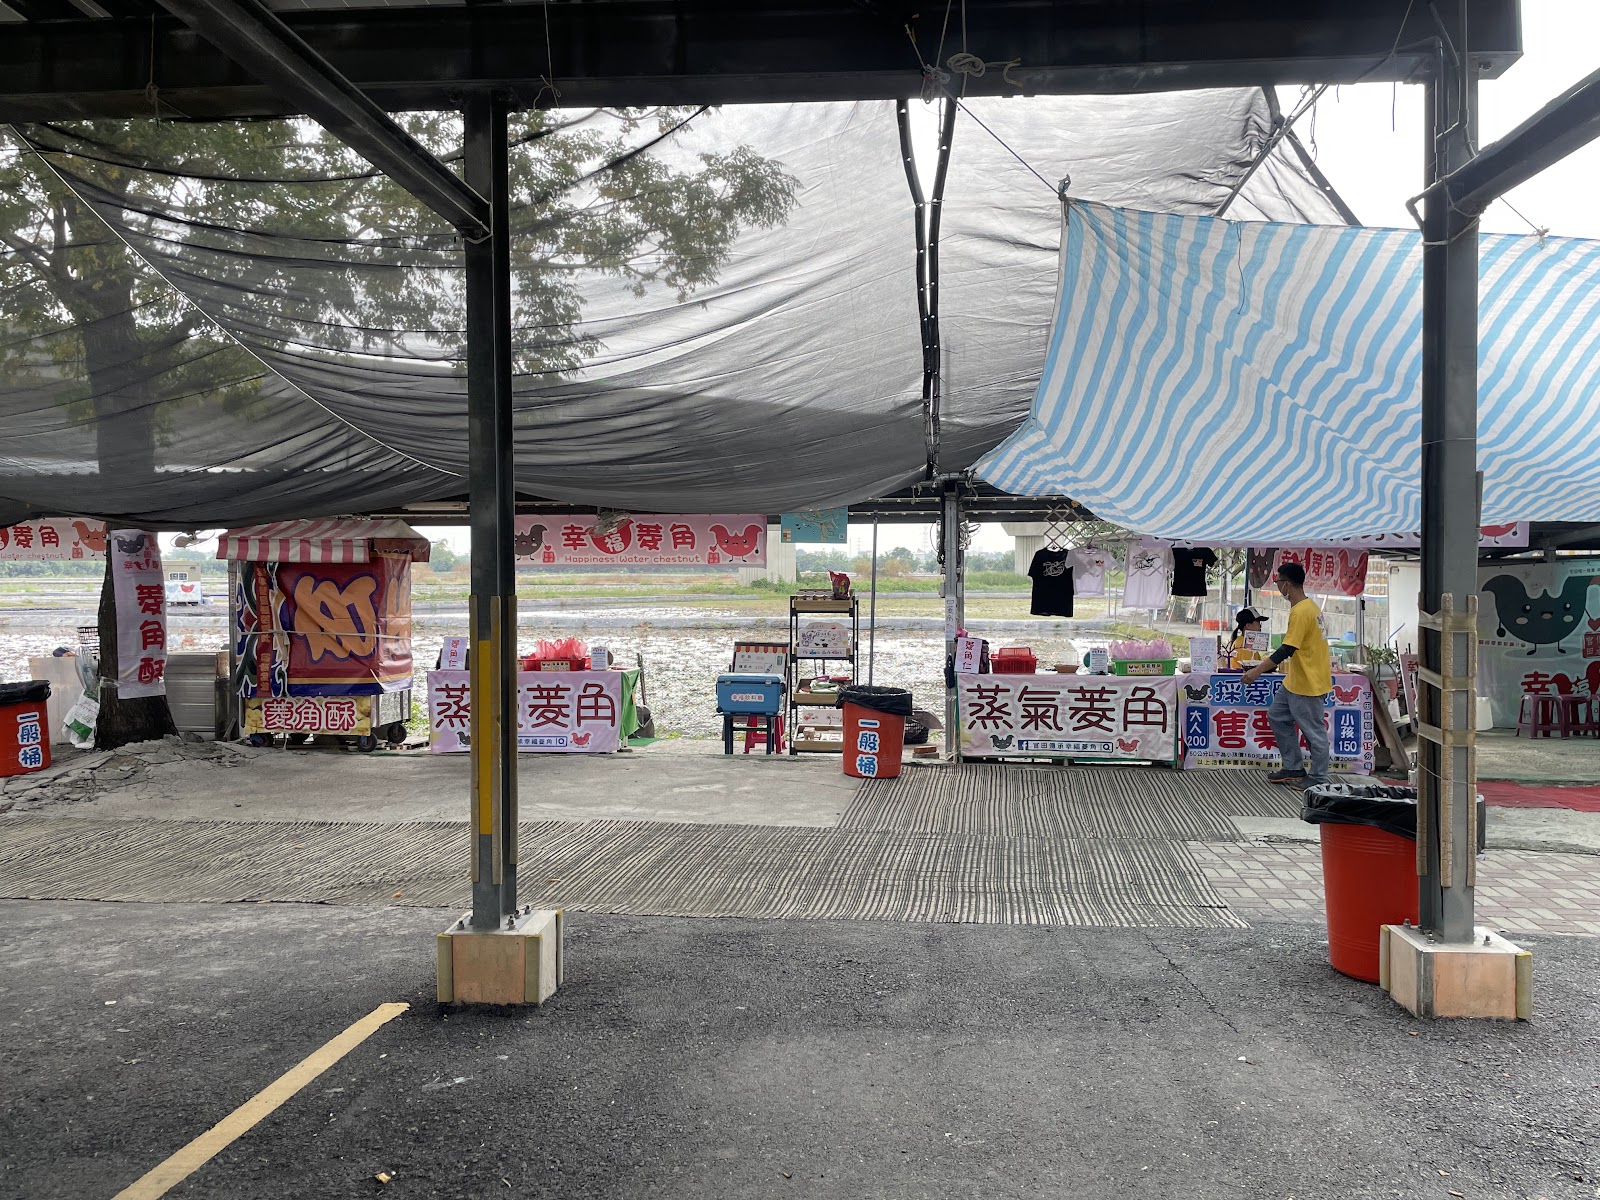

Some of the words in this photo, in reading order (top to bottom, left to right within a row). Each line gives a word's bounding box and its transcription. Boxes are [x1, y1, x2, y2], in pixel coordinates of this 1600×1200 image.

[1, 525, 59, 549] 菱角
[562, 523, 697, 552] 幸福菱角
[27, 551, 64, 560] chestnut
[565, 555, 612, 564] Happiness
[619, 555, 651, 563] Water
[654, 555, 701, 563] chestnut
[136, 584, 166, 686] 菱角酥
[263, 697, 357, 732] 菱角酥
[435, 683, 616, 728] 蒸菱角
[967, 684, 1167, 734] 蒸氣菱角
[1190, 710, 1202, 734] 大人
[1340, 713, 1355, 739] 小孩
[18, 712, 42, 767] 一般桶
[858, 720, 880, 777] 一般桶
[1186, 736, 1206, 747] 200
[1338, 740, 1357, 752] 150
